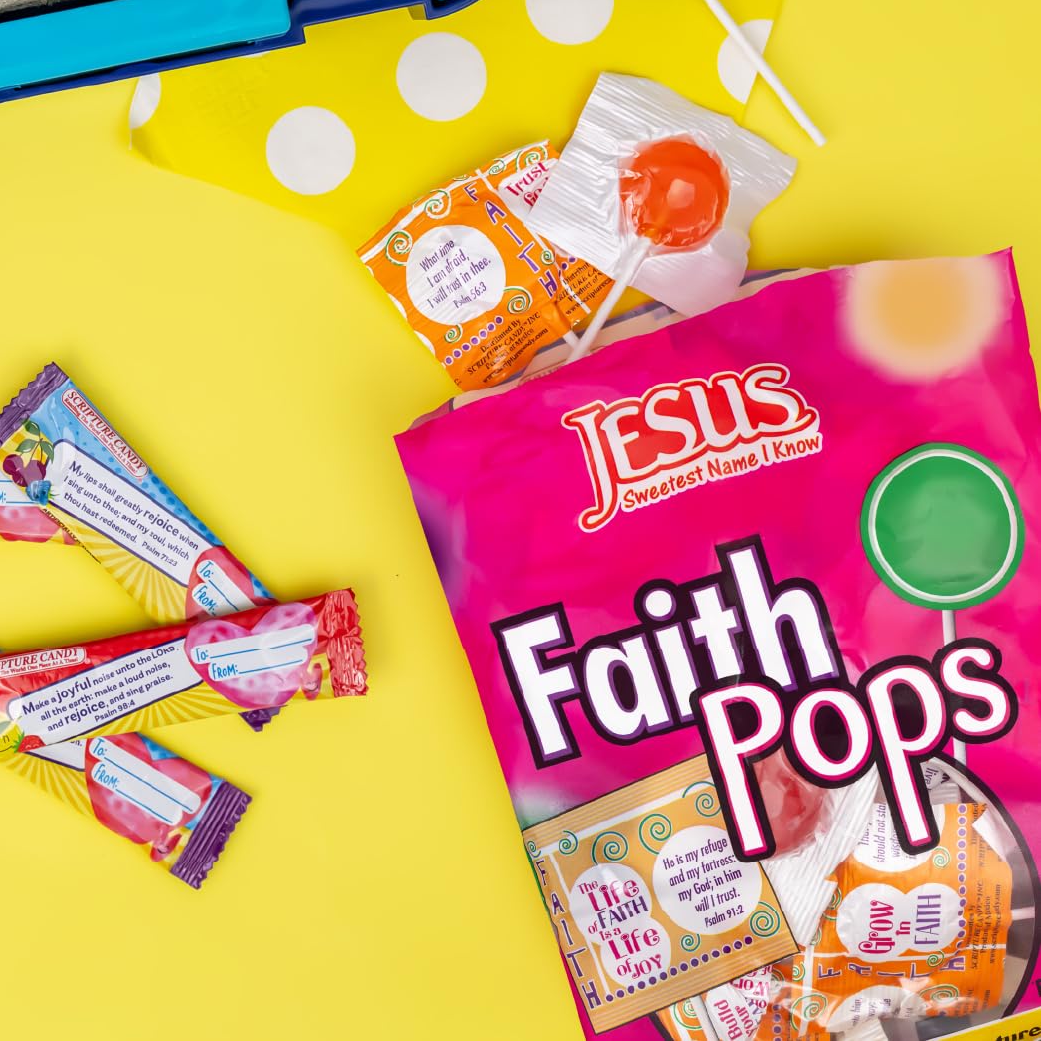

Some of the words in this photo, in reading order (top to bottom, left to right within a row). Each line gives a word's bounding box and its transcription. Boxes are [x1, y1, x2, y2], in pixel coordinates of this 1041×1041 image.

[564, 366, 817, 530] JESUS
[623, 466, 703, 509] Sweetest
[708, 454, 758, 476] Name
[762, 444, 770, 462] I
[773, 435, 820, 459] Know
[68, 460, 84, 477] My
[83, 472, 98, 485] lips
[97, 482, 117, 497] shall
[114, 494, 143, 515] greatly
[142, 509, 179, 537] rejoice
[178, 533, 199, 550] when
[503, 548, 838, 761] Faith
[47, 718, 64, 731] and
[64, 700, 109, 724] rejoice,
[109, 691, 125, 705] and
[125, 685, 145, 697] sing
[144, 674, 173, 692] praise.
[699, 648, 1009, 856] Pops
[674, 854, 684, 865] is
[684, 849, 698, 863] my
[700, 838, 728, 857] refuge
[578, 879, 599, 895] The
[669, 868, 685, 887] and
[685, 866, 700, 880] my
[677, 888, 692, 902] my
[693, 877, 714, 895] God;
[712, 875, 724, 886] in
[722, 869, 742, 882] him
[587, 878, 640, 912] Life
[694, 896, 710, 912] will
[710, 894, 715, 907] I
[716, 887, 740, 905] trust.
[588, 921, 599, 935] of
[597, 895, 649, 929] FAITH
[608, 927, 661, 959] Life
[616, 960, 632, 978] of
